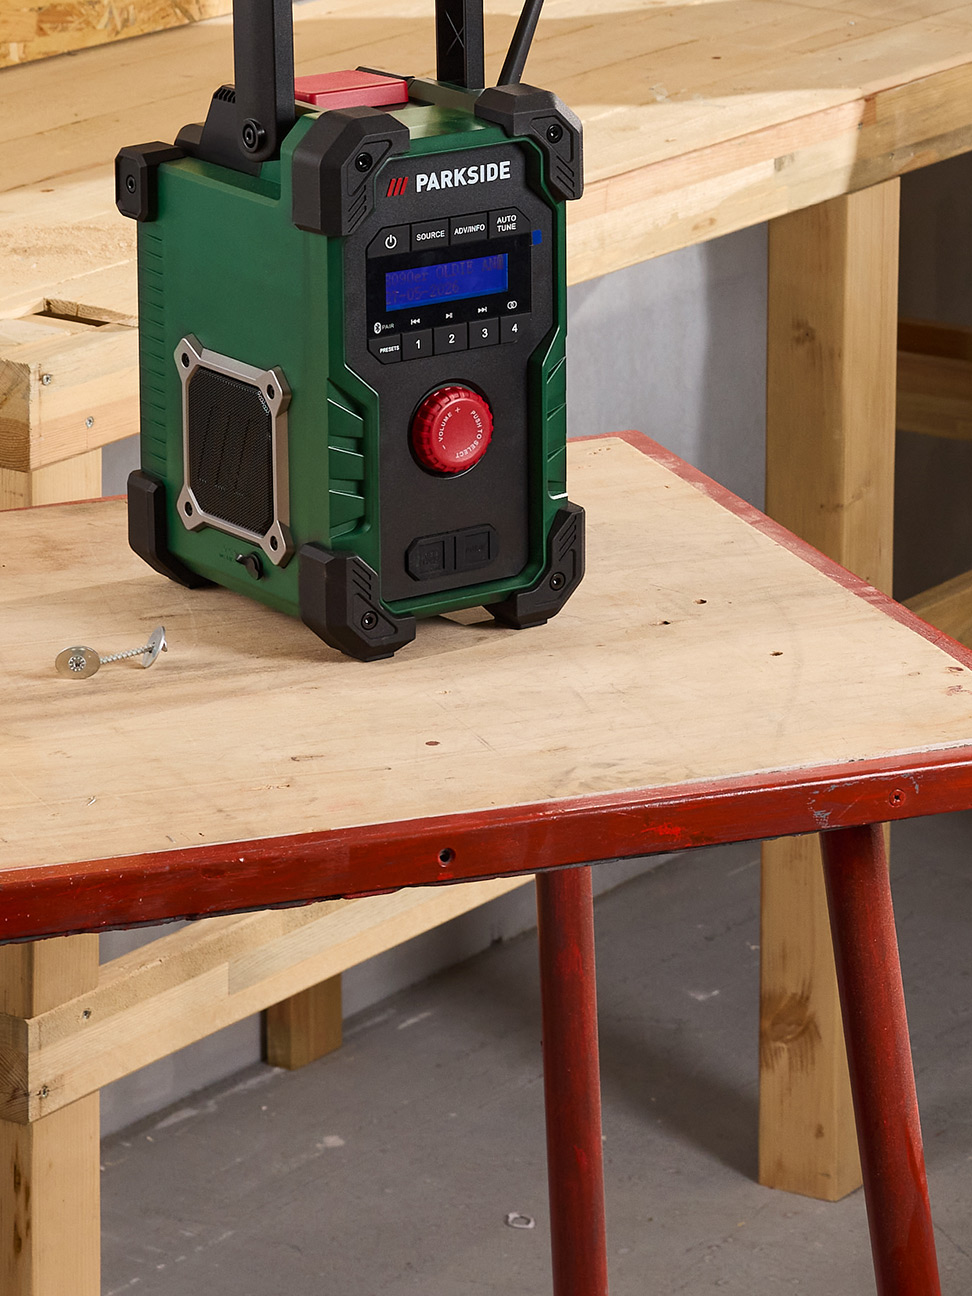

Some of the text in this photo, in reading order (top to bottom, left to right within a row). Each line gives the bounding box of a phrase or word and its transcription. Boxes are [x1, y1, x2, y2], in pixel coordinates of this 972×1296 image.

[415, 160, 512, 193] PARKSIDE
[496, 214, 517, 224] AUTO
[453, 223, 486, 236] ADV/INFO
[496, 222, 517, 233] TUNE
[416, 230, 446, 242] SOURCE
[382, 322, 395, 331] PAIR
[379, 322, 518, 354] PRESETS 1 2 3 4
[438, 411, 453, 442] VOLUME
[455, 410, 483, 459] PUSH TO SELECT
